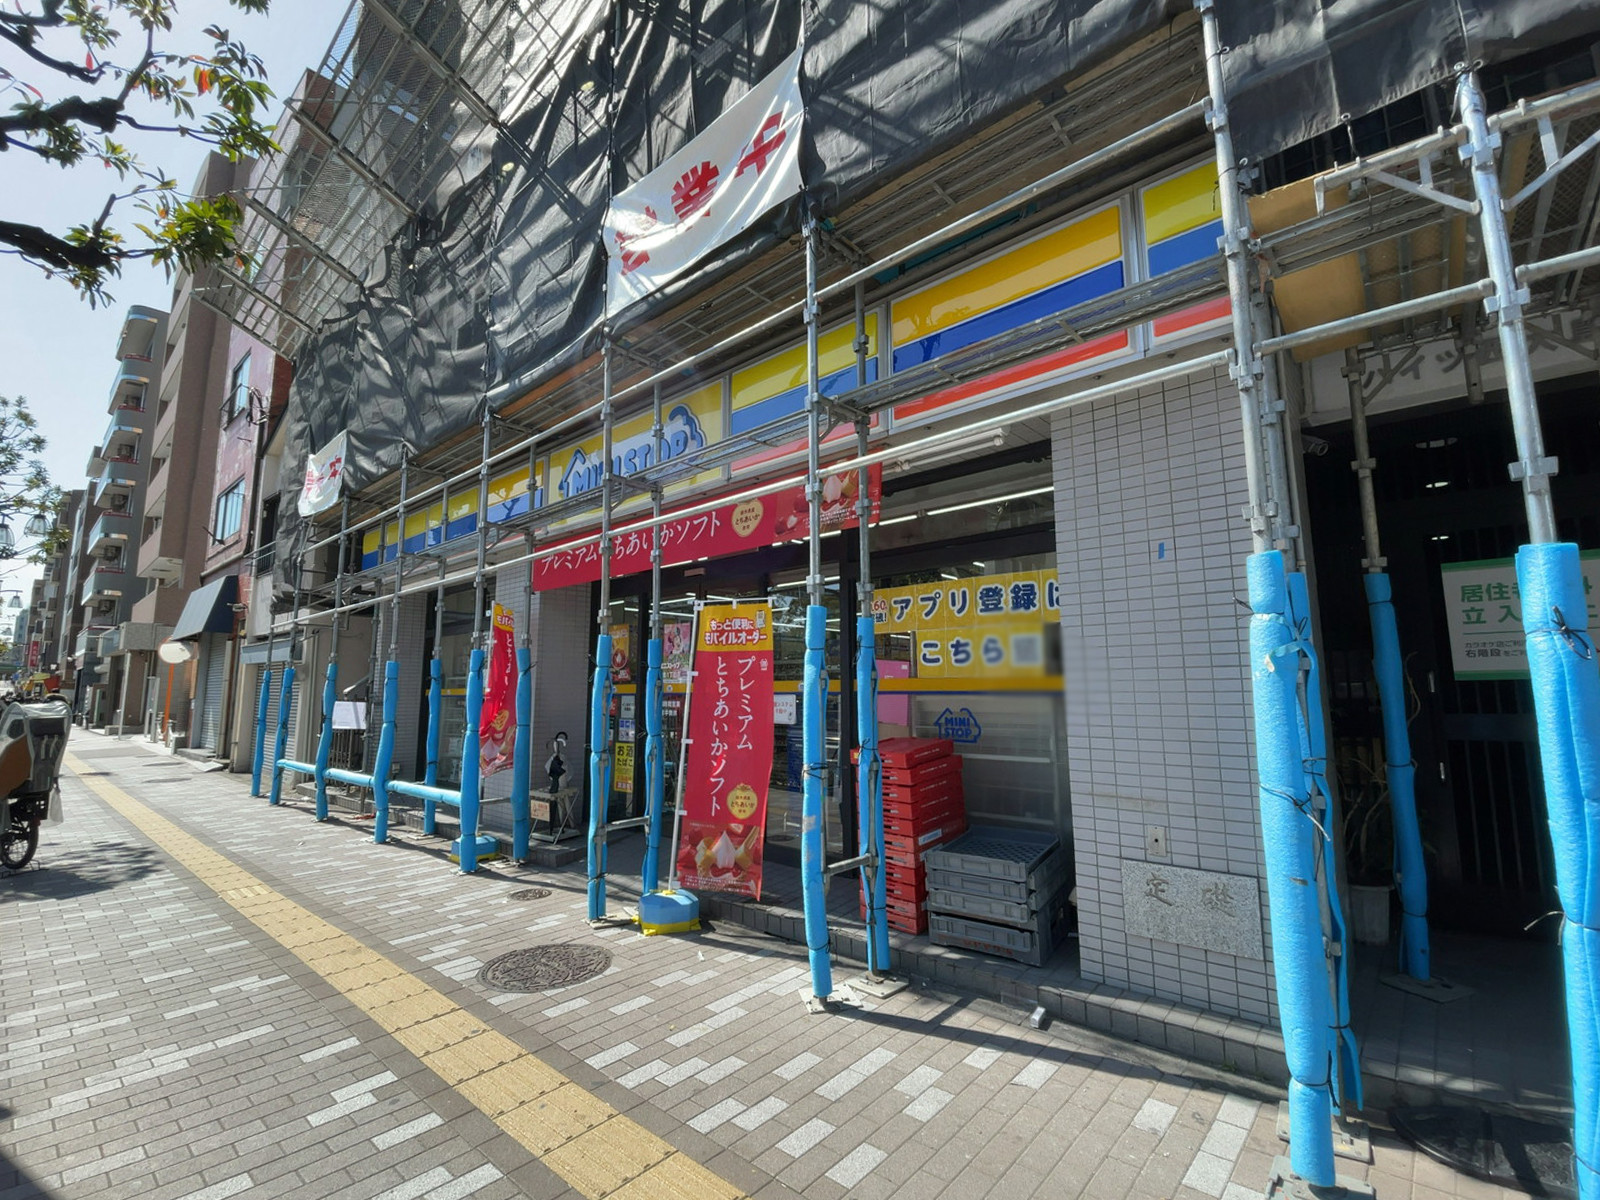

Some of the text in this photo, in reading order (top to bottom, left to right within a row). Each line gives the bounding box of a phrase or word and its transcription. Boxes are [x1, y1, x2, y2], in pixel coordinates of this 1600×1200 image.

[711, 618, 754, 630] もっと便利に
[705, 630, 767, 645] モバイルオーダー
[921, 637, 1004, 665] こちら
[737, 655, 756, 750] プレミアム
[944, 716, 970, 726] MINI
[710, 656, 729, 817] とちあいかソフト
[944, 727, 972, 738] STOP
